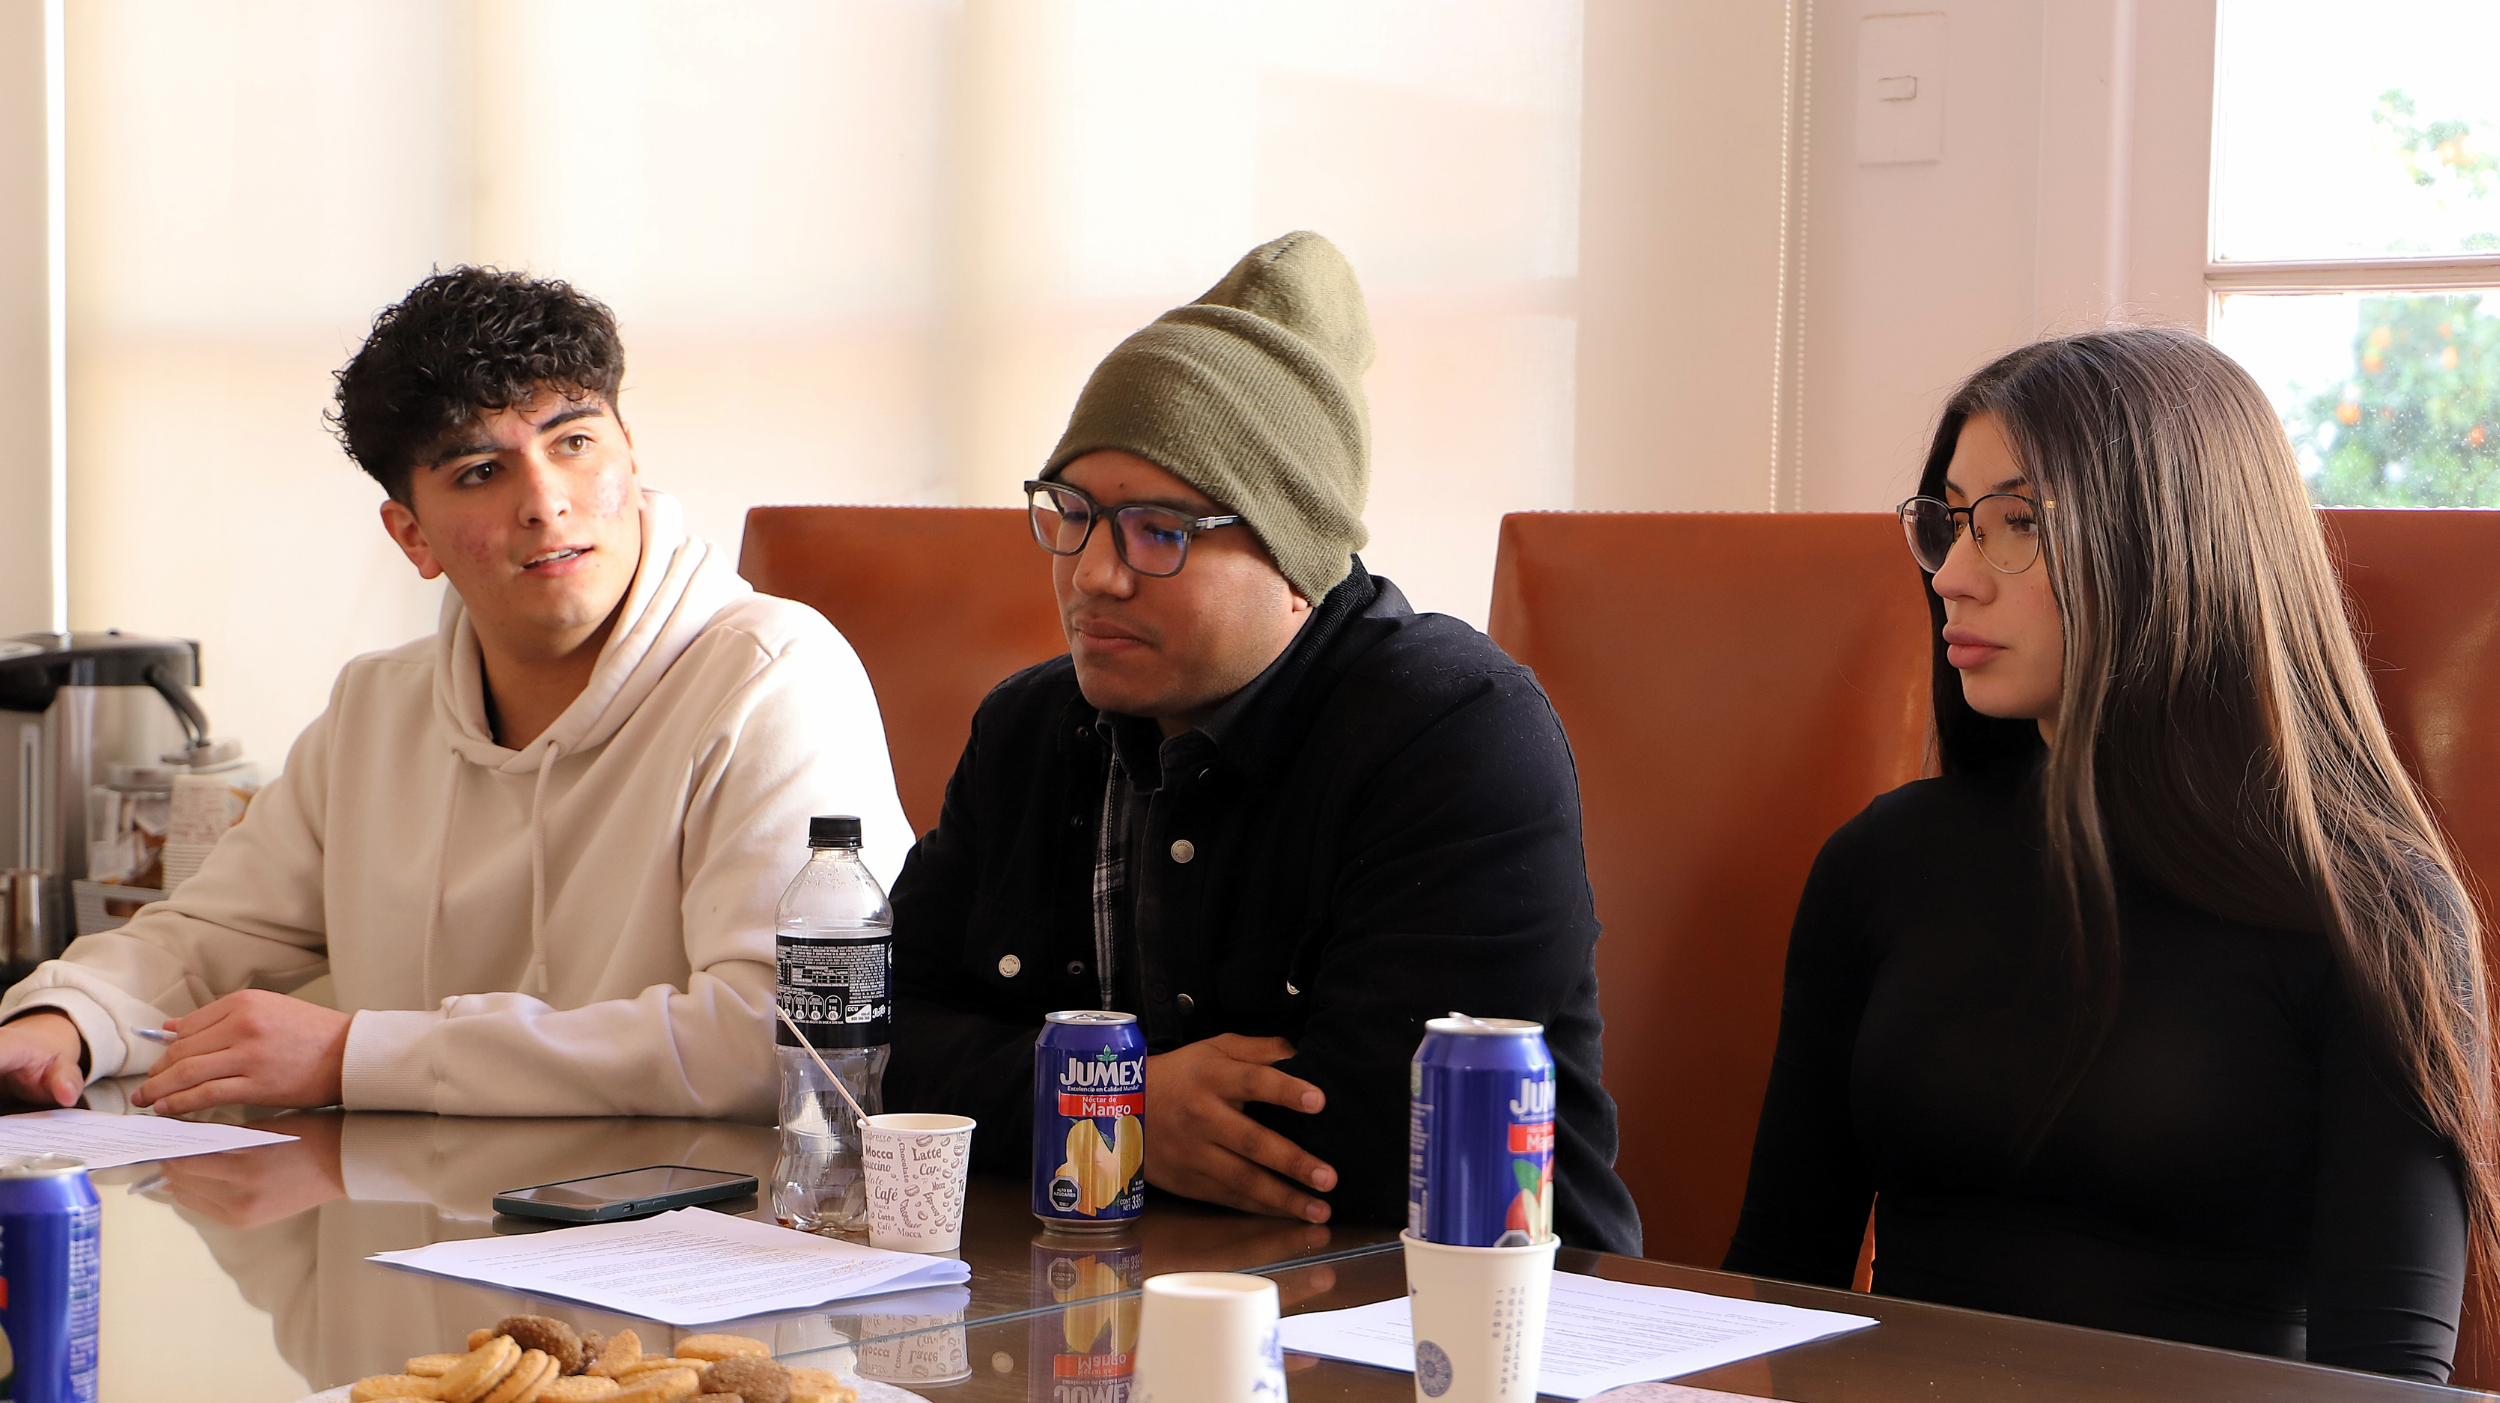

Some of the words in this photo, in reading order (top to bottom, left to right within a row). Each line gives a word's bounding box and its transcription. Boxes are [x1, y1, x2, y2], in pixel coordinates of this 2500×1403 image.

[1060, 1056, 1144, 1087] JUMEX
[1082, 1103, 1131, 1120] Mango
[865, 1144, 894, 1160] Mocca
[911, 1147, 942, 1161] Latte
[898, 1142, 909, 1183] Chocolate
[875, 1185, 898, 1204] Café
[900, 1199, 922, 1229] Chocolate
[877, 1222, 892, 1230] Café
[896, 1227, 922, 1239] Mocca
